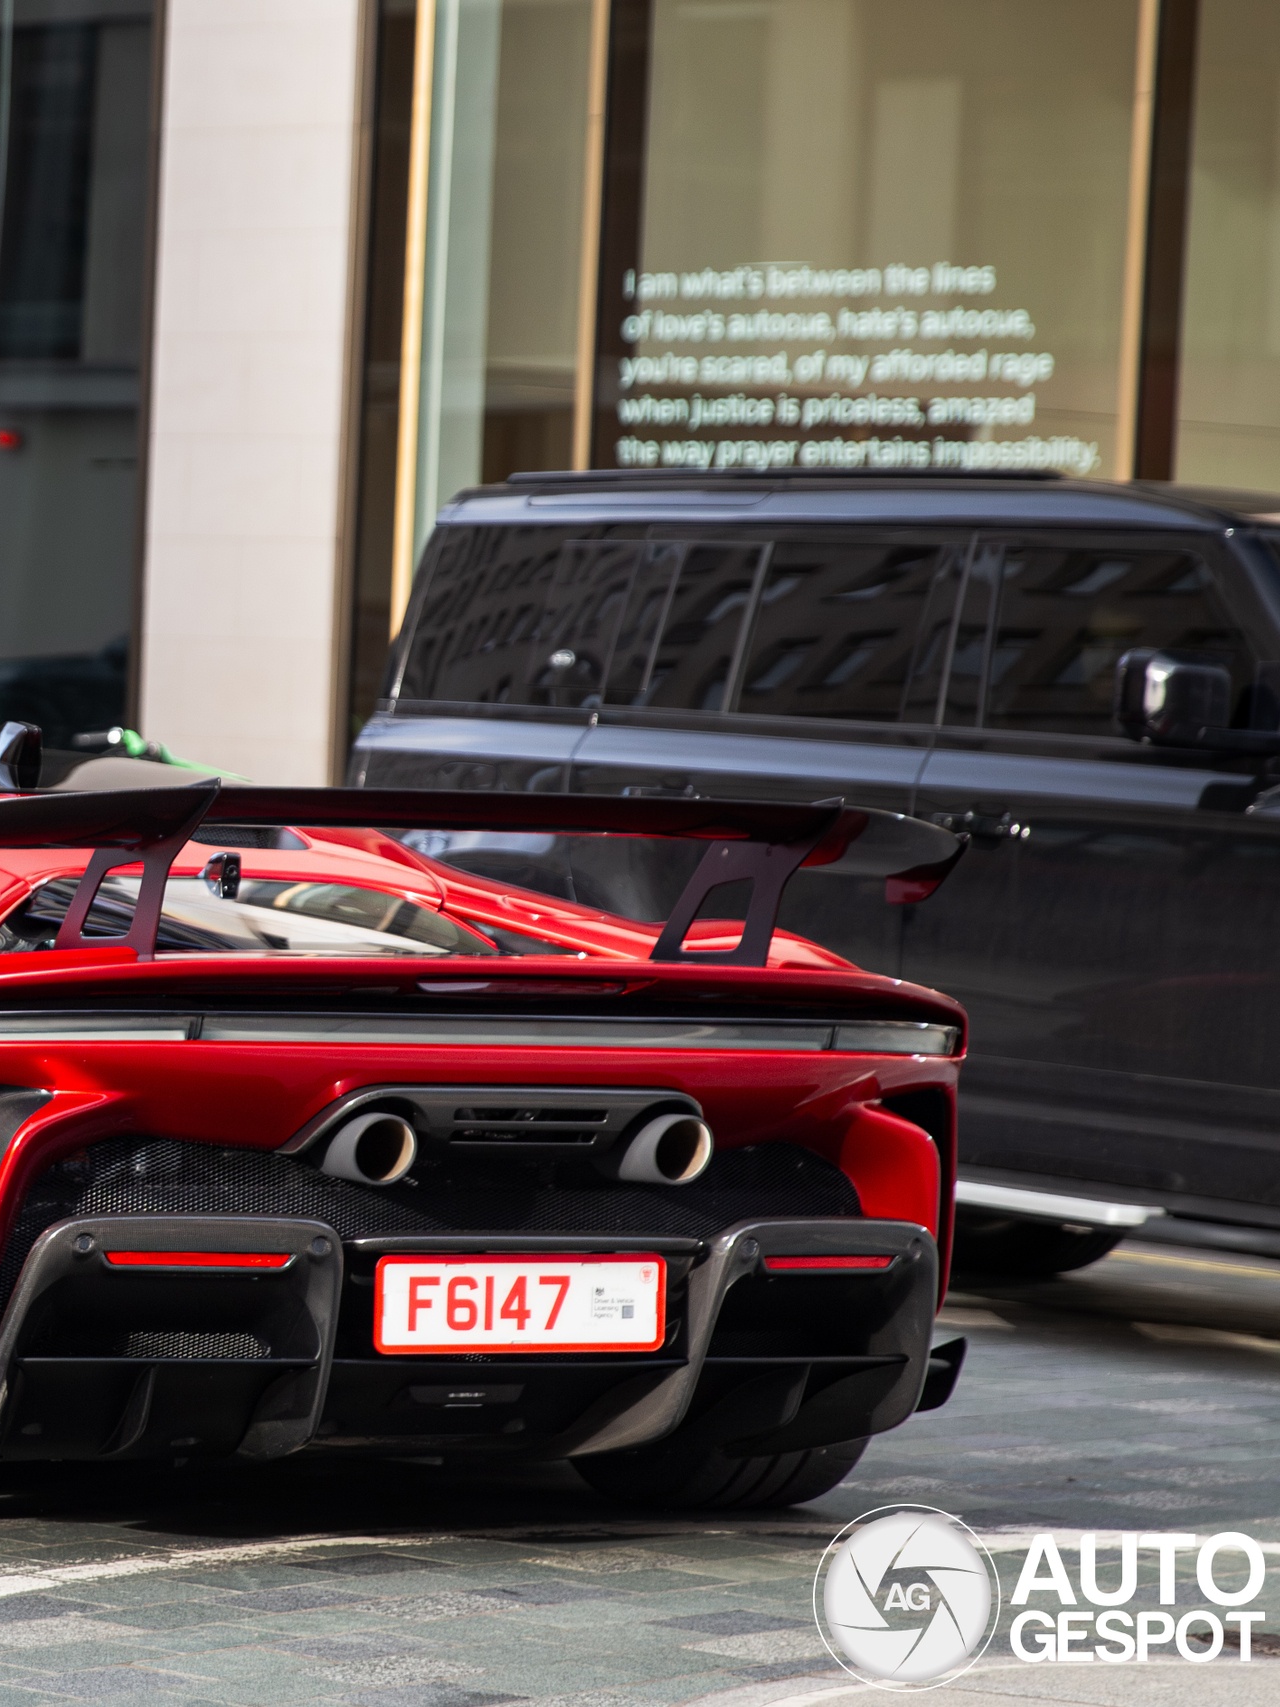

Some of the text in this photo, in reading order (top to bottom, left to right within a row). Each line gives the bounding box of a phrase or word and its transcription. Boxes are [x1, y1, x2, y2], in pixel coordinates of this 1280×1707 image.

[636, 272, 678, 299] am
[679, 267, 765, 299] what's
[766, 266, 882, 299] between
[884, 262, 930, 297] the
[931, 261, 996, 296] lines
[622, 309, 654, 343] of
[654, 309, 725, 342] love's
[837, 307, 918, 340] hate's
[619, 349, 1055, 389] you're scared, of my afforded rage
[618, 391, 1036, 432] when justice is priceless, amazed
[616, 435, 660, 468] the
[661, 439, 716, 471] way
[714, 440, 799, 472] prayer
[797, 436, 932, 468] entertains
